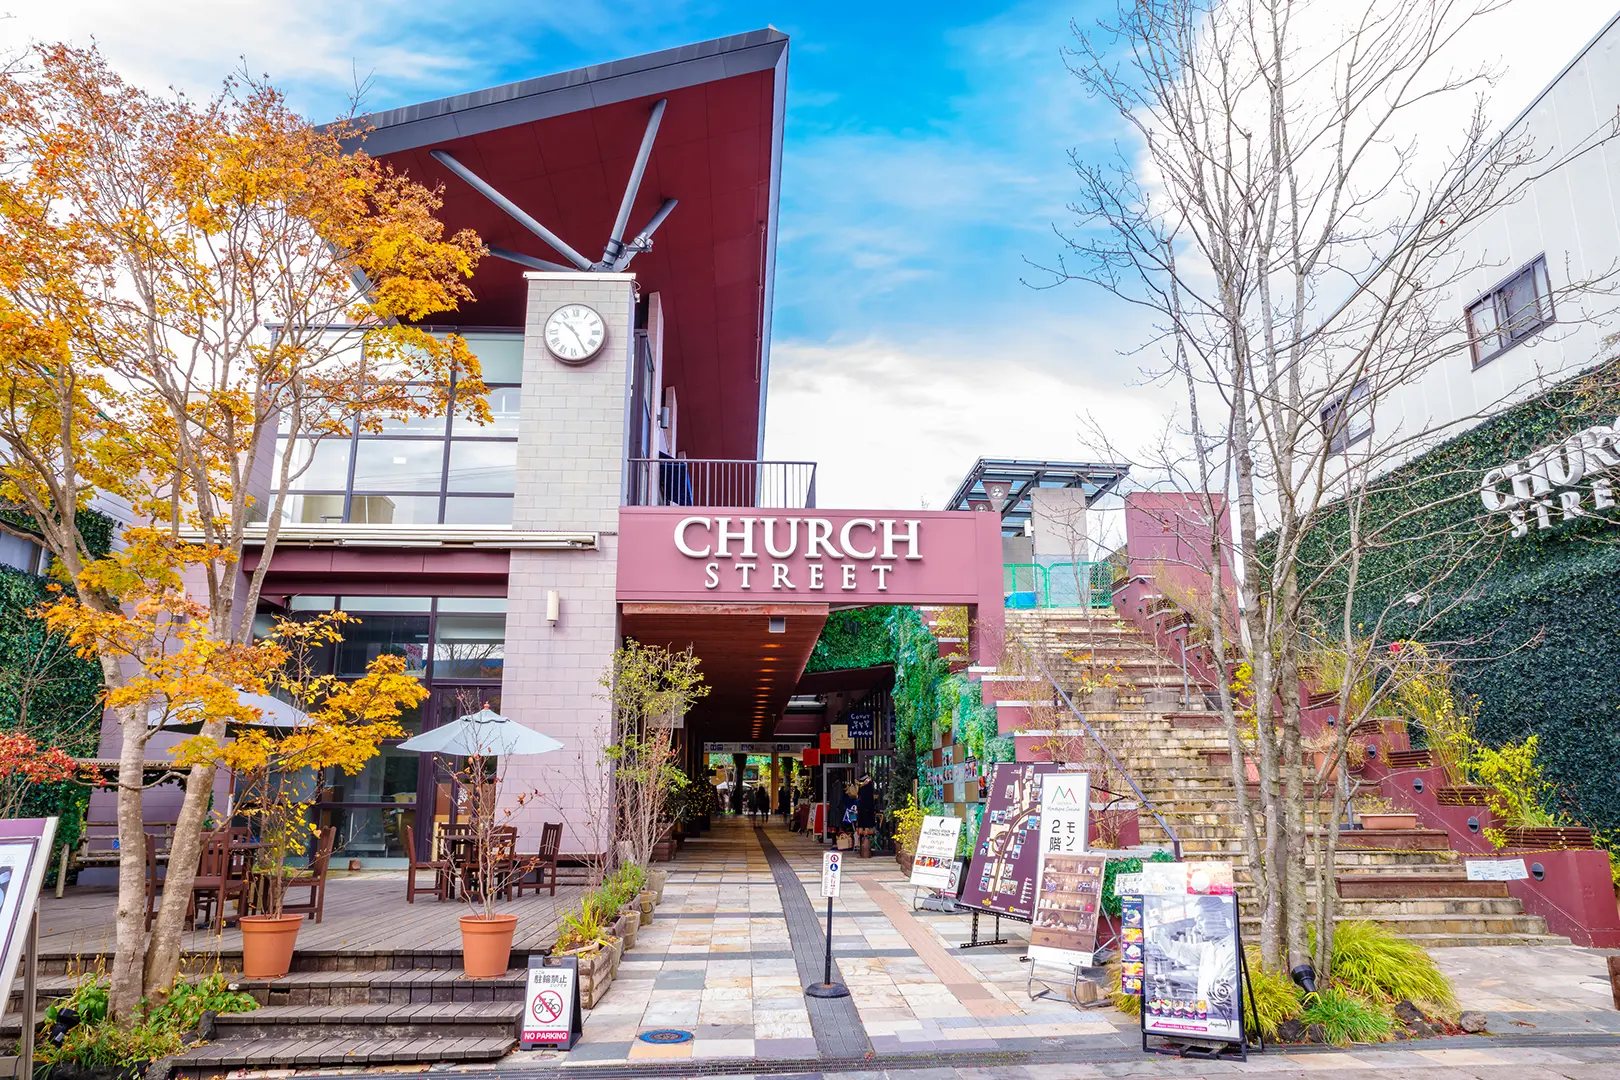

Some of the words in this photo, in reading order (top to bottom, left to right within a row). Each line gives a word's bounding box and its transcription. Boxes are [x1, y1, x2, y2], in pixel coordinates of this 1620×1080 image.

[1480, 416, 1620, 511] CHUR
[673, 516, 924, 560] CHURCH
[704, 562, 893, 591] STREET
[534, 974, 567, 984] 駐輪禁止
[524, 1032, 535, 1040] NO
[536, 1032, 567, 1040] PARKING
